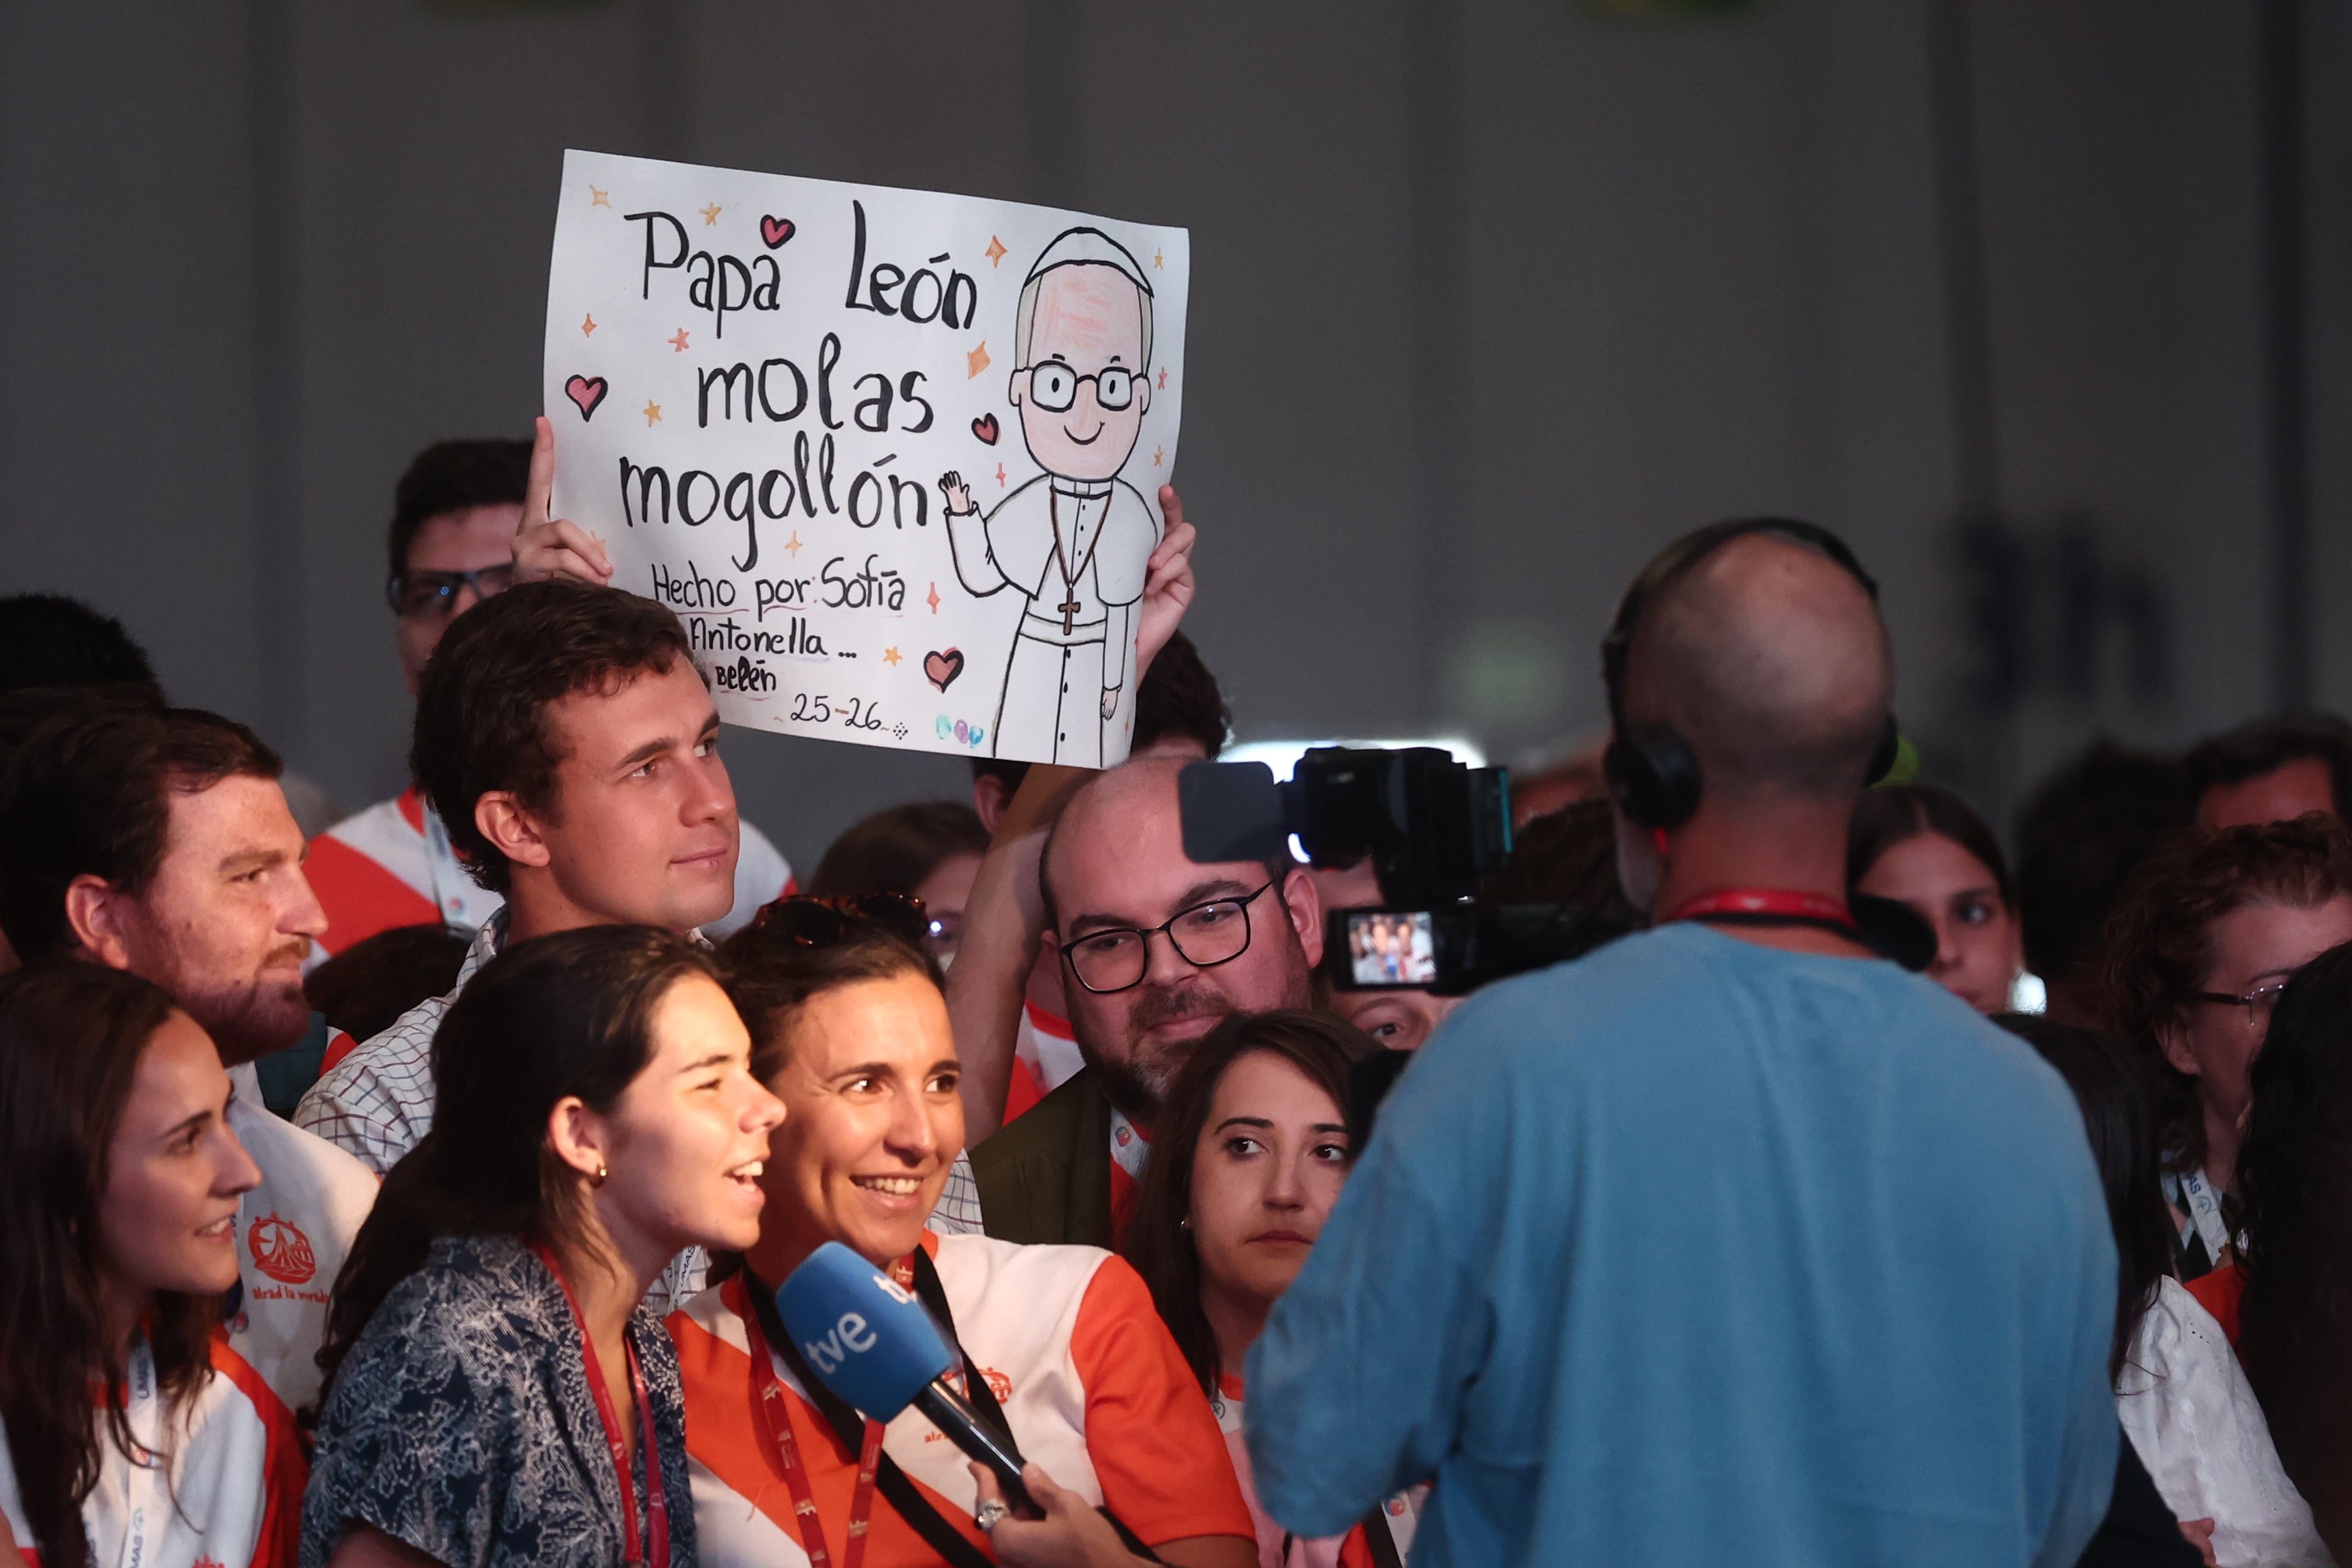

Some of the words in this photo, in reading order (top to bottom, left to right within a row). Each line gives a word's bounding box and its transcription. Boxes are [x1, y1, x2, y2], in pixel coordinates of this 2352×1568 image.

[846, 199, 977, 329] León
[698, 332, 934, 432] molas
[619, 431, 928, 572] mogollón
[651, 560, 736, 608] Hecho
[821, 553, 905, 611] Sofía
[715, 655, 776, 692] Belén
[805, 1312, 878, 1375] tve
